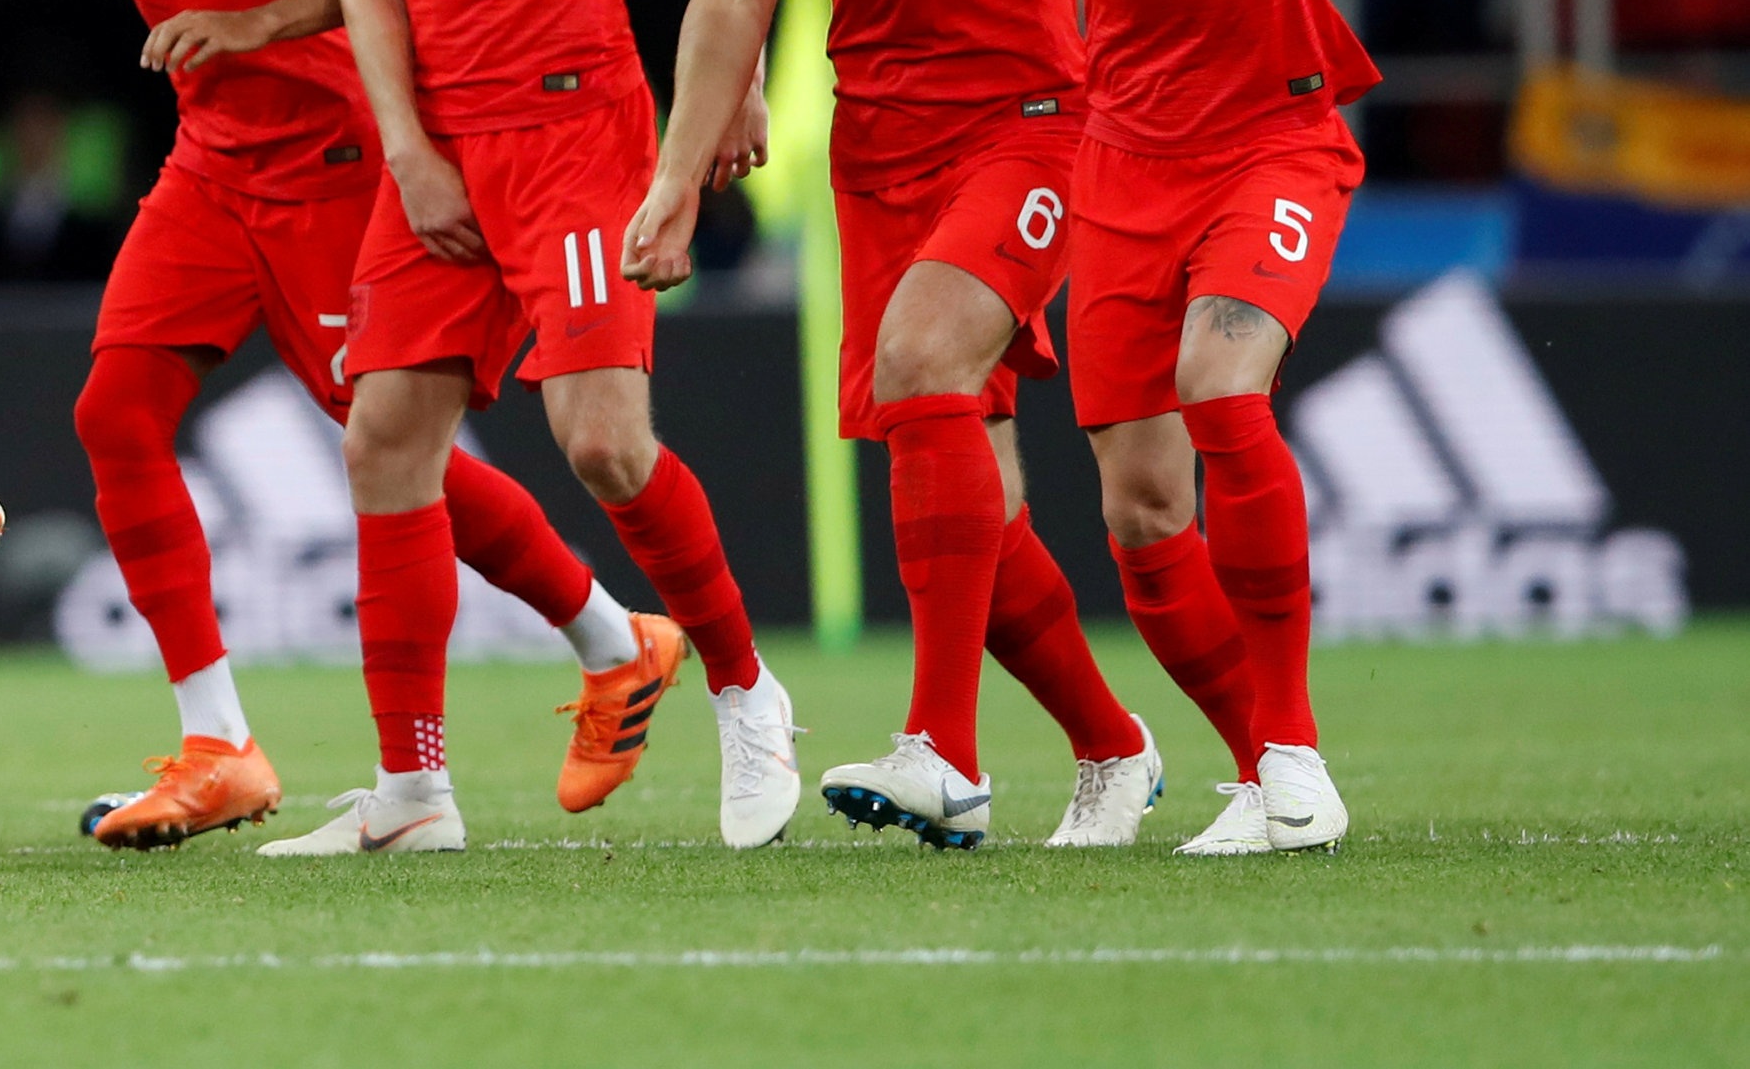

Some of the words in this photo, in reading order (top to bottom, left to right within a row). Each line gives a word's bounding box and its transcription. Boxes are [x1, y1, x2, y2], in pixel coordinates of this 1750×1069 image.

[1016, 186, 1064, 249] 6
[1269, 197, 1313, 262] 5
[563, 227, 608, 308] 11
